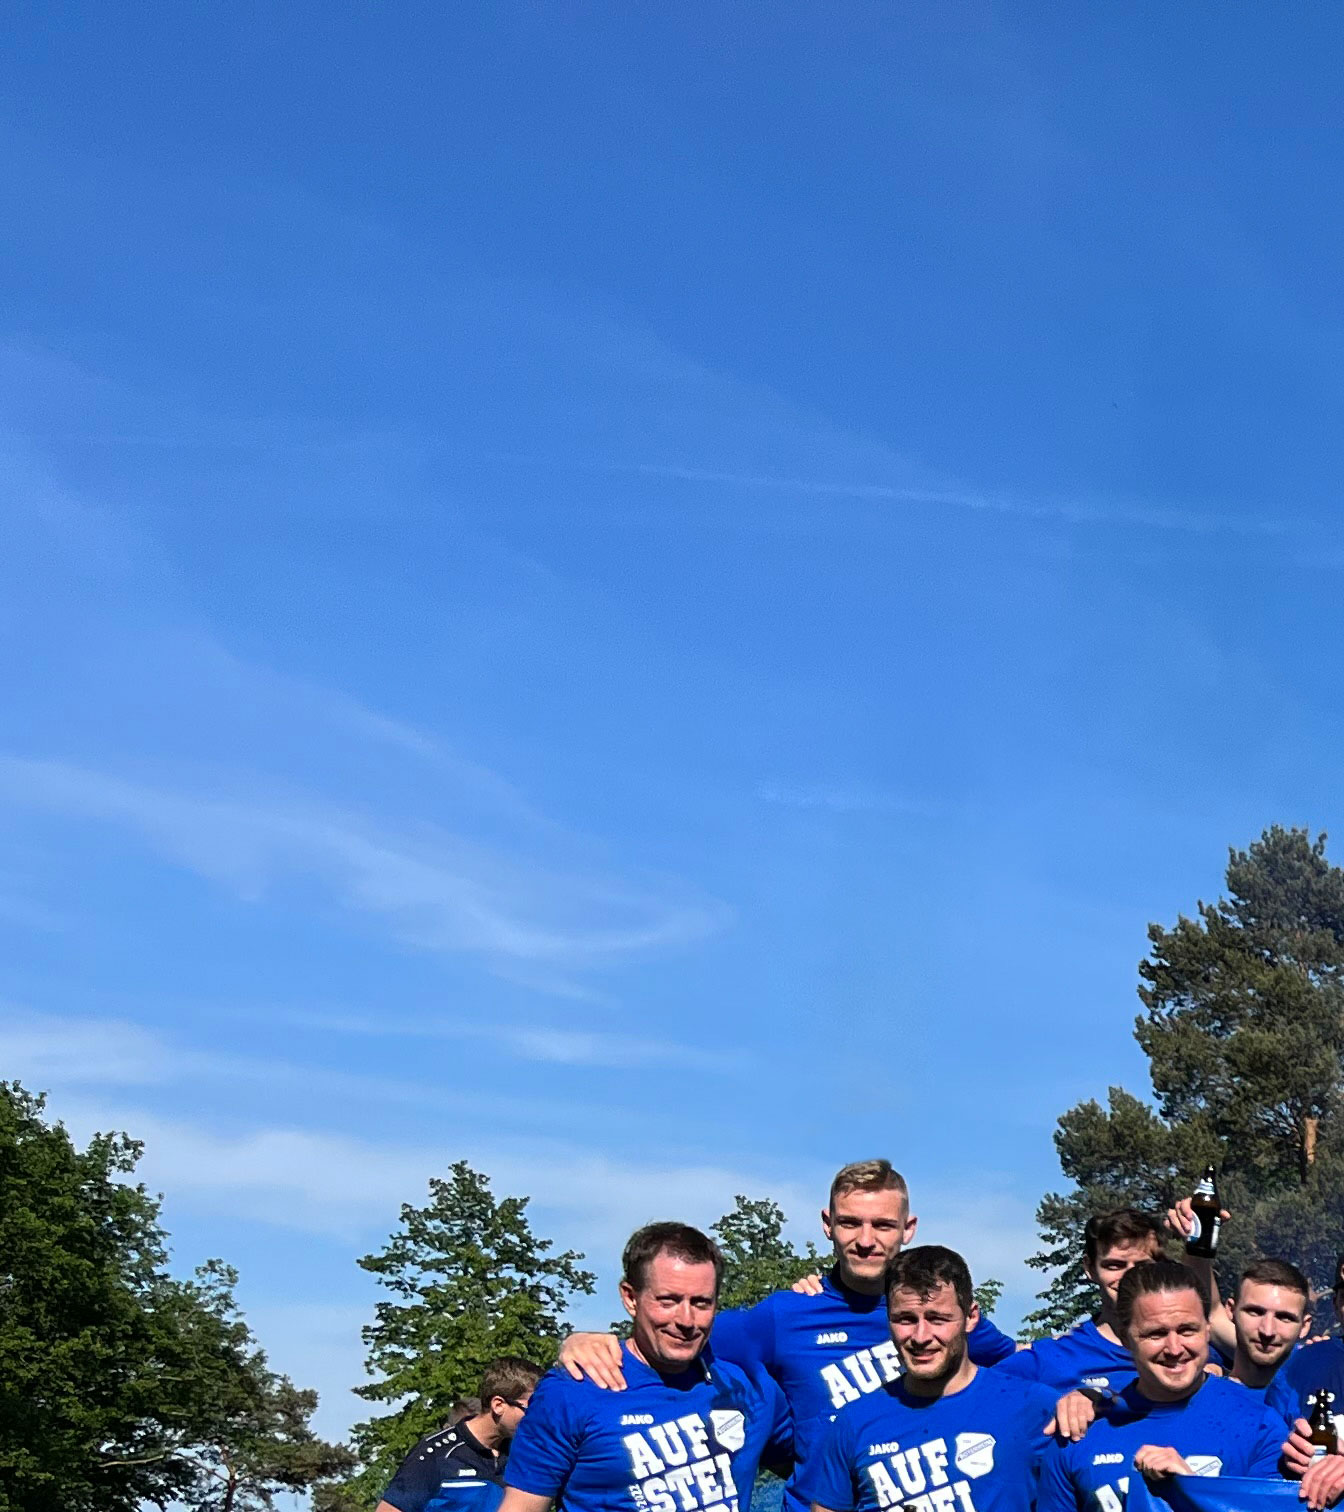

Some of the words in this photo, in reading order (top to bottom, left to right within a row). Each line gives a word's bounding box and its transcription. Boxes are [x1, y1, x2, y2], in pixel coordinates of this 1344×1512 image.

[816, 1331, 848, 1345] JAKO
[820, 1340, 901, 1410] AUF
[620, 1414, 655, 1427] JAKO
[623, 1413, 711, 1480] AUF
[869, 1441, 900, 1456] JAKO
[1092, 1453, 1125, 1466] JAKO
[868, 1437, 949, 1508] AUF
